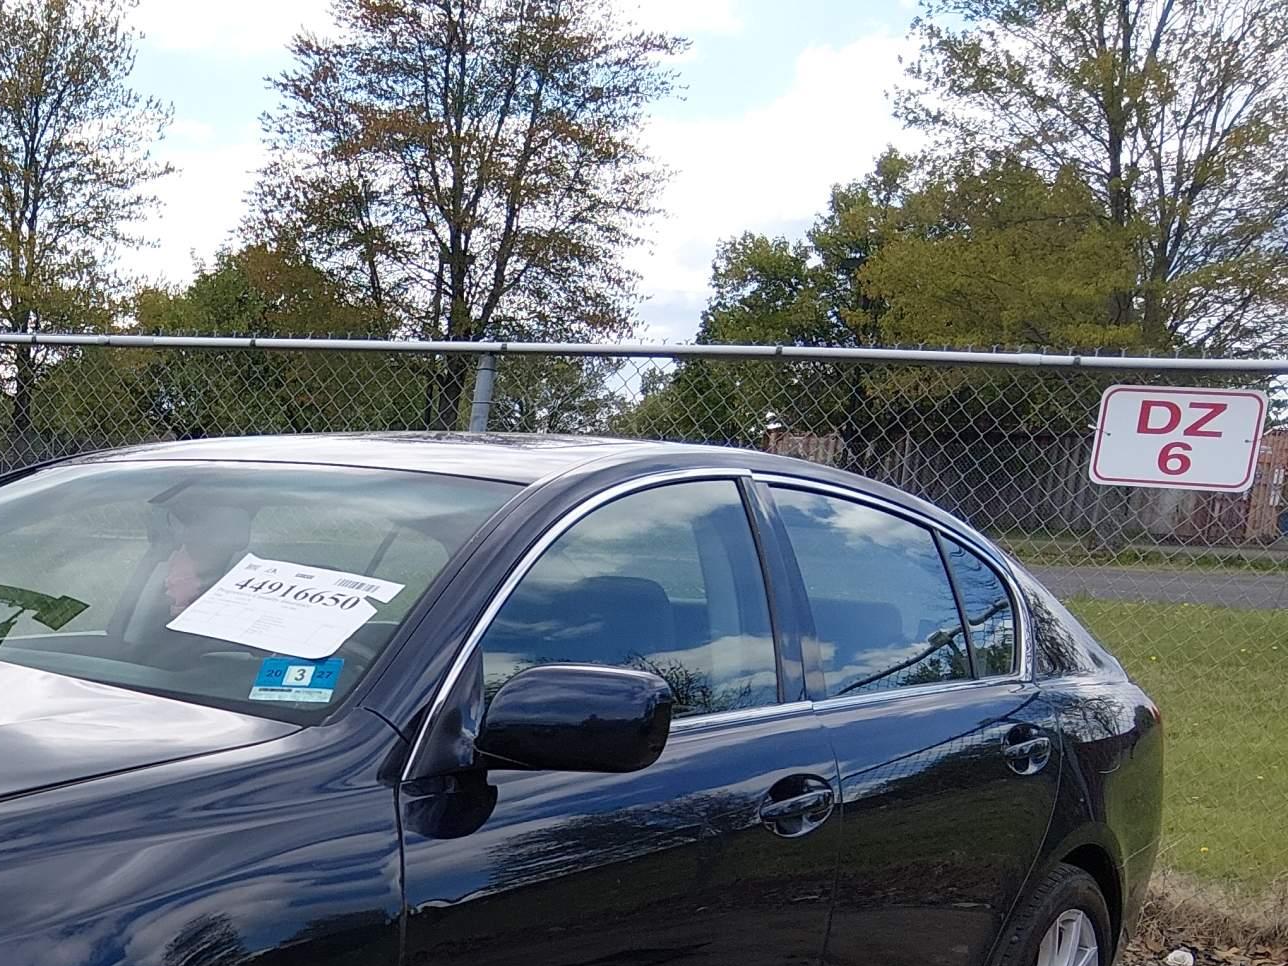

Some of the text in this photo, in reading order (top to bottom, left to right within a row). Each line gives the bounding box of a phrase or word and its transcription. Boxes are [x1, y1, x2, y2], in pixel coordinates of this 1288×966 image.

[1136, 400, 1228, 438] DZ
[1157, 441, 1193, 476] 6
[235, 577, 360, 610] 44916650
[294, 668, 306, 681] 3
[317, 671, 333, 679] 27
